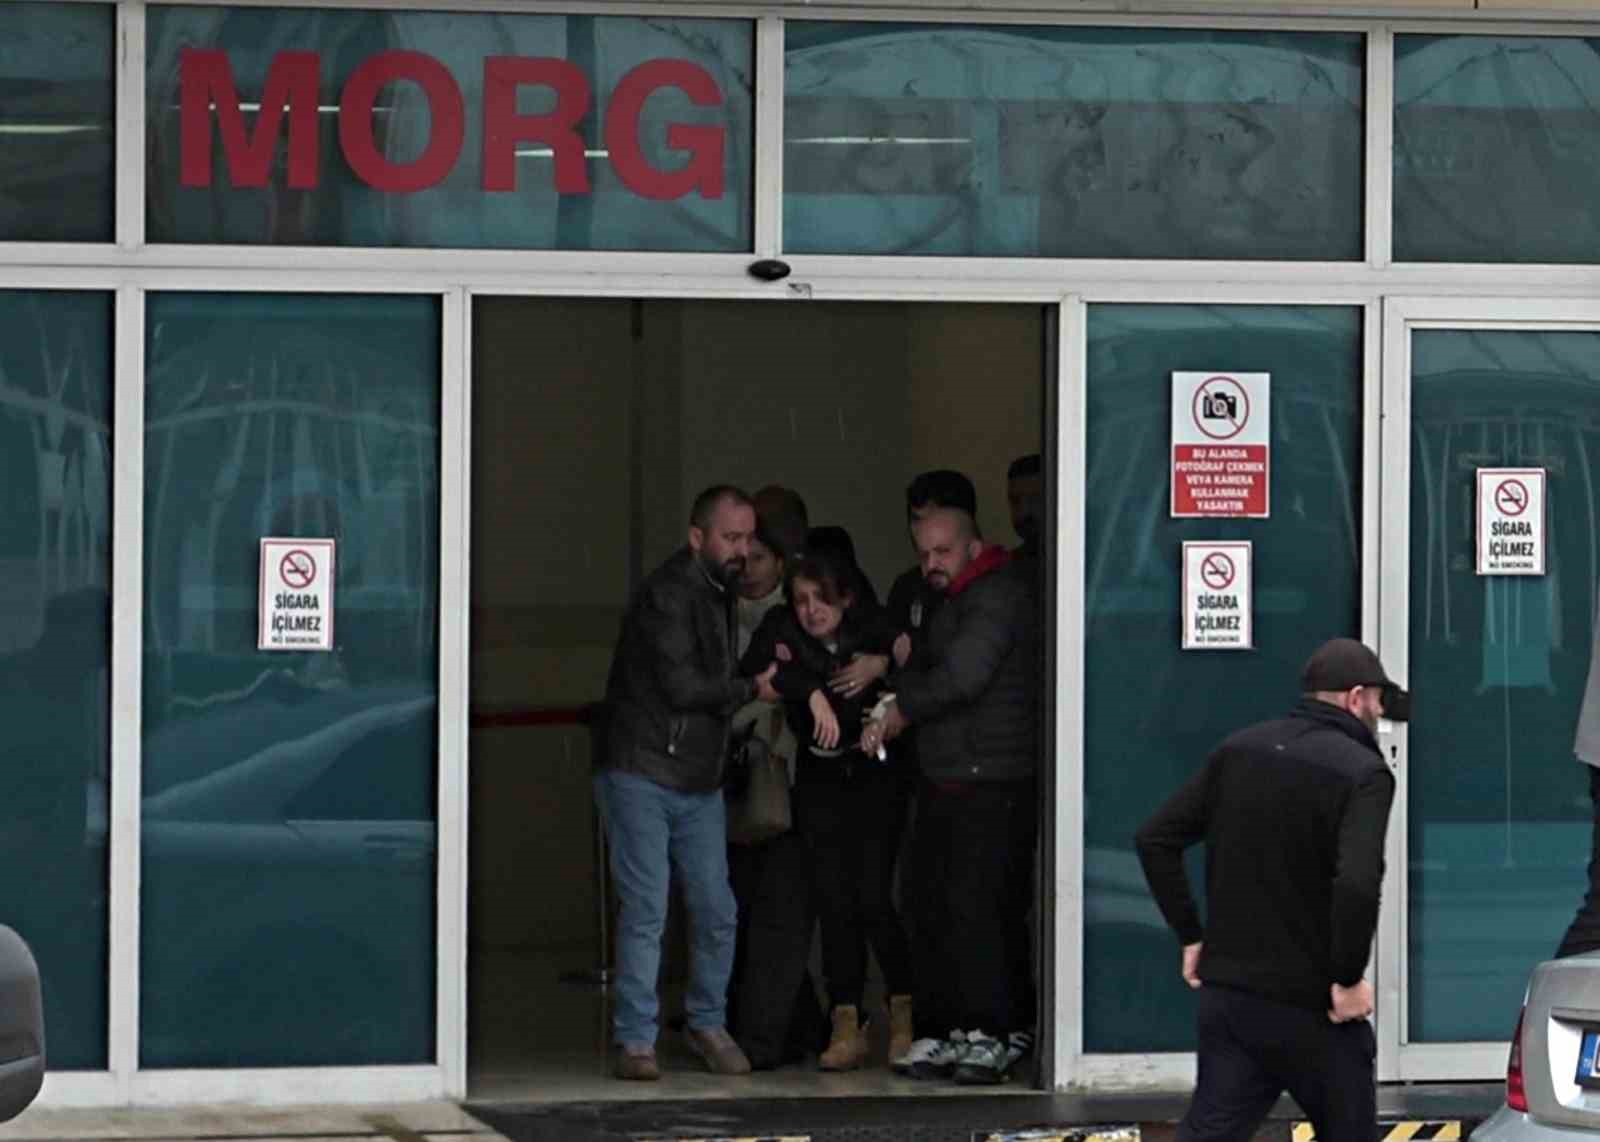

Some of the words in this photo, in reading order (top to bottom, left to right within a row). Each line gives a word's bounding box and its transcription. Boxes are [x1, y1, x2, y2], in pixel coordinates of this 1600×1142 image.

[178, 47, 727, 202] MORG
[1192, 448, 1206, 459] BU
[1208, 448, 1248, 459] ALANDA
[1226, 461, 1265, 473] ÇEKMEK
[1186, 474, 1212, 485] VEYA
[1214, 475, 1254, 486] KAMERA
[1190, 487, 1249, 498] KULLANMAK
[1196, 500, 1244, 511] YASAKTIR
[1491, 517, 1533, 537] SİGARA
[1488, 538, 1535, 561] İÇİLMEZ
[274, 589, 319, 610] SİGARA
[1197, 591, 1239, 610] SİGARA
[271, 611, 322, 635] İÇİLMEZ
[1194, 611, 1241, 634] İÇİLMEZ
